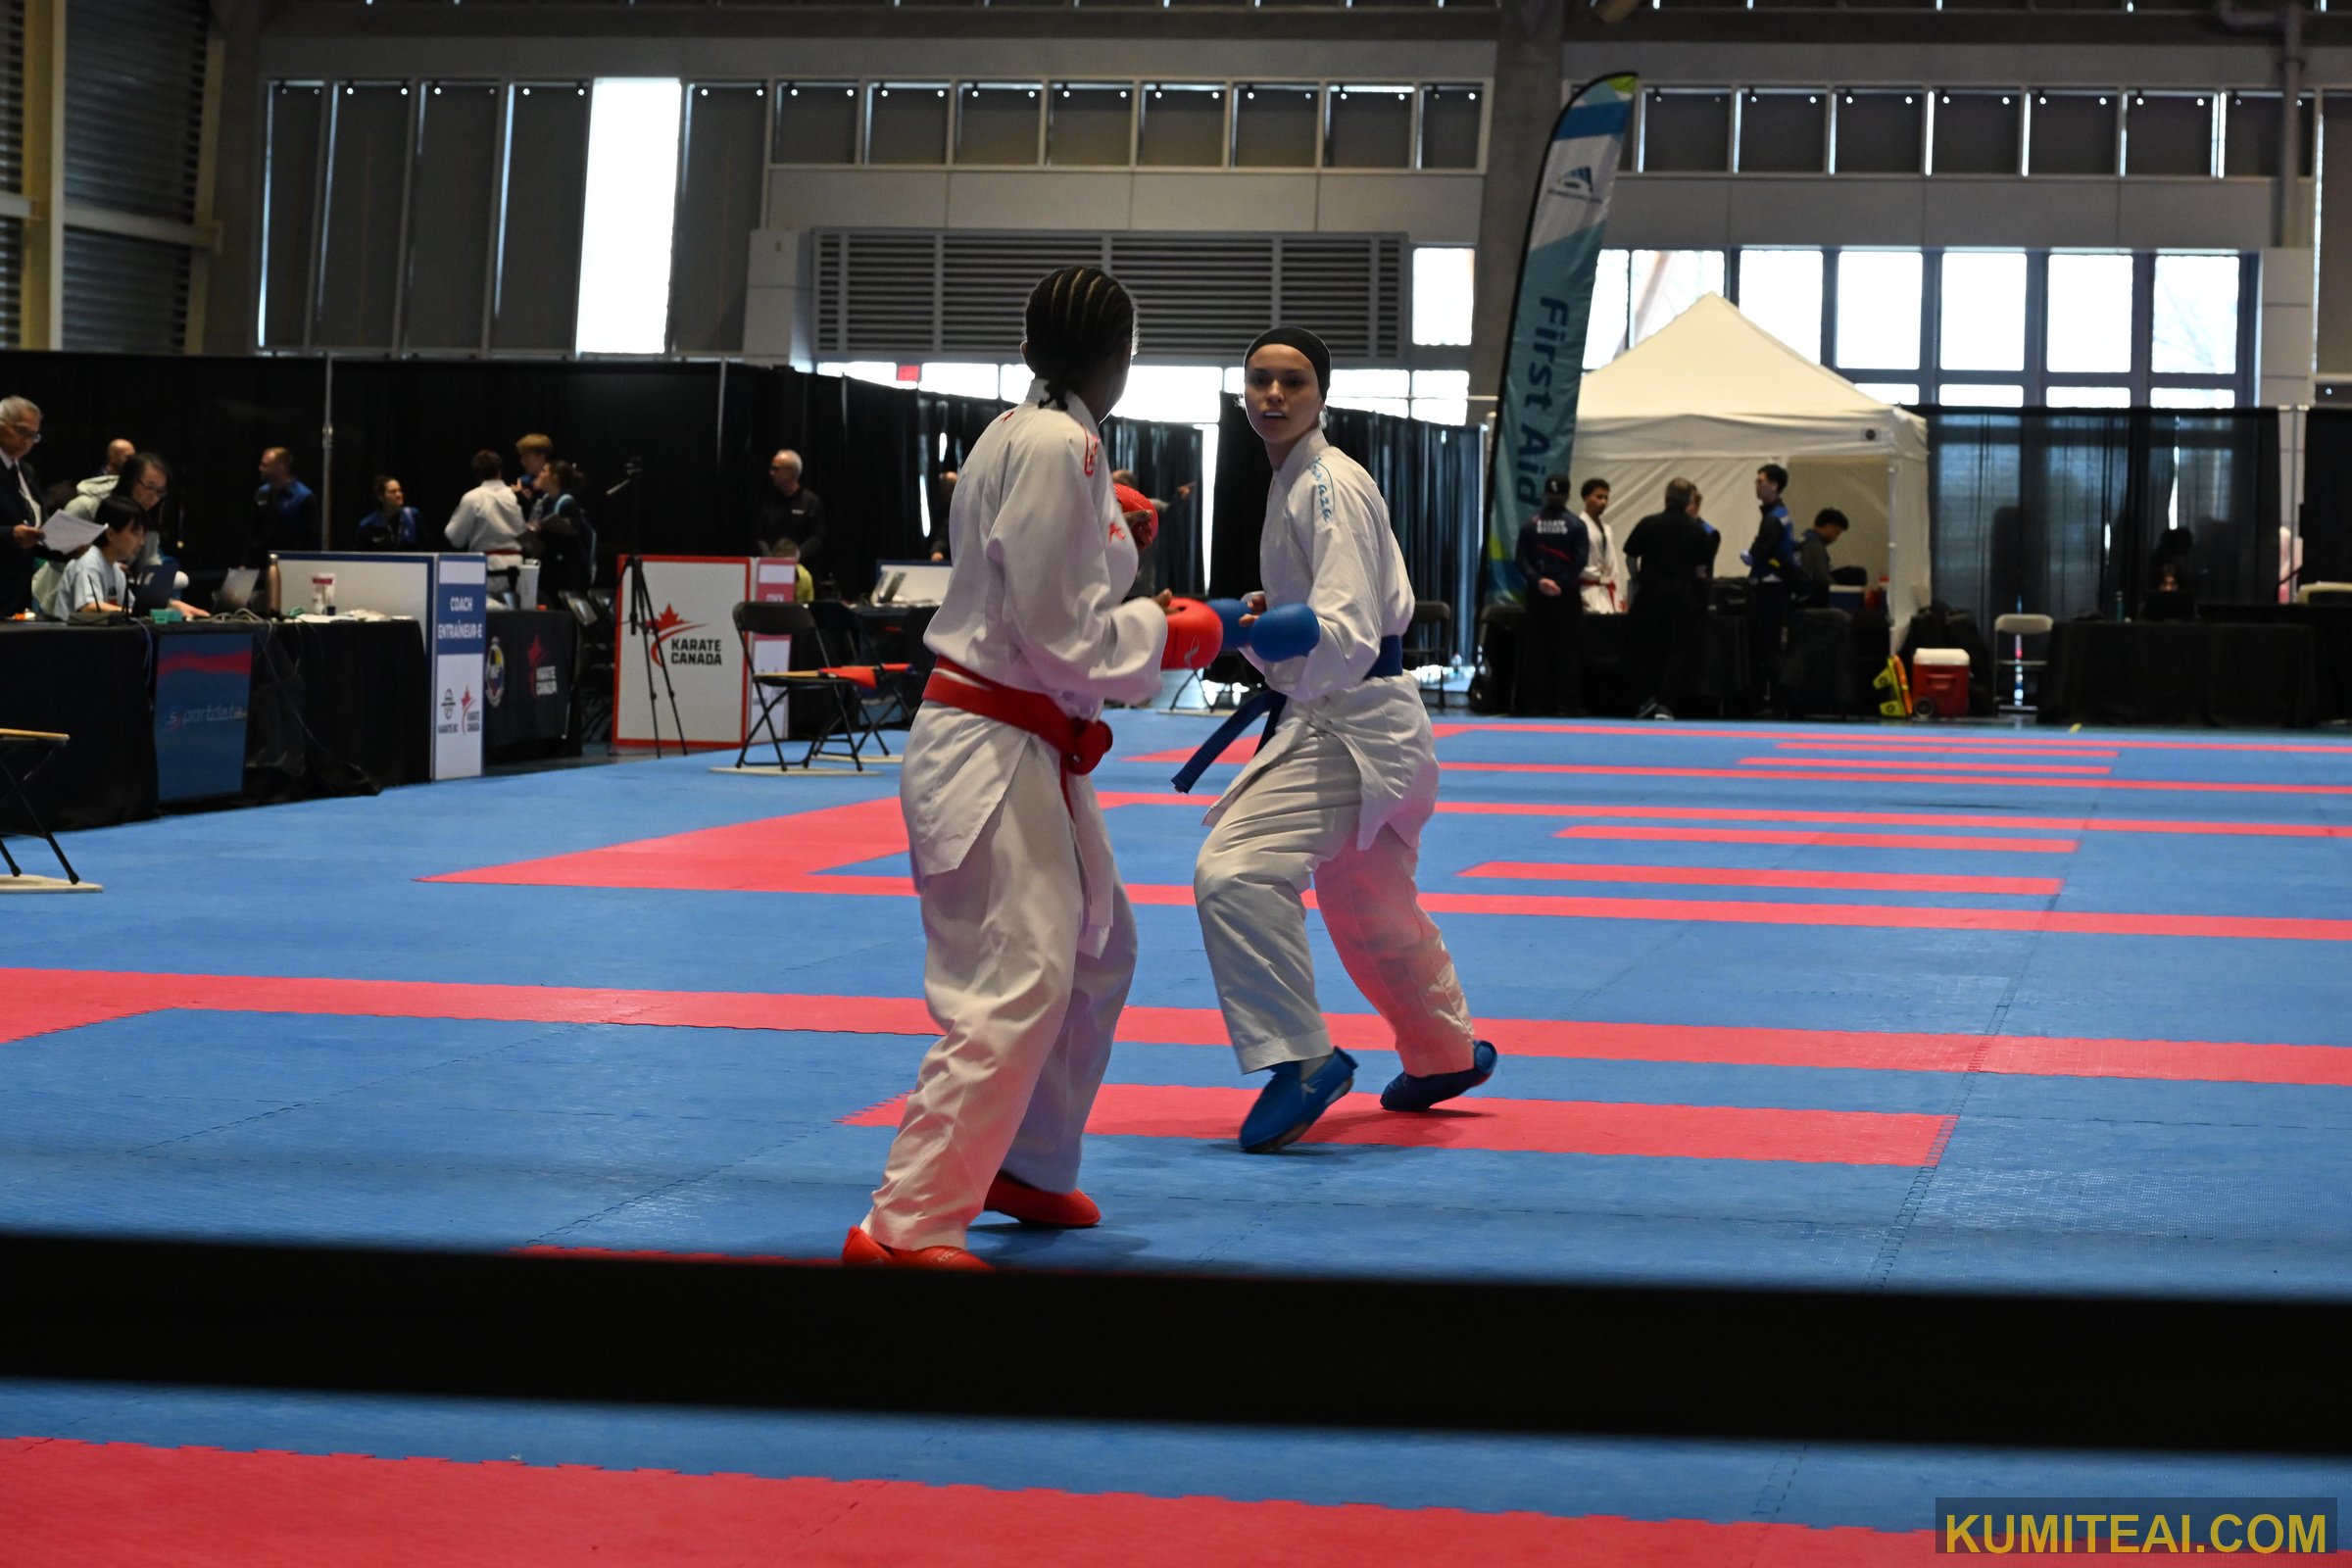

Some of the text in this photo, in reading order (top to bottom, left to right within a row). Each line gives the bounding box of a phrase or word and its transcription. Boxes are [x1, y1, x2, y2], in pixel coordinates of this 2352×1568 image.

[1517, 297, 1568, 507] First Aid
[450, 596, 473, 612] COACH
[671, 639, 721, 652] KARATE
[671, 653, 722, 665] CANADA
